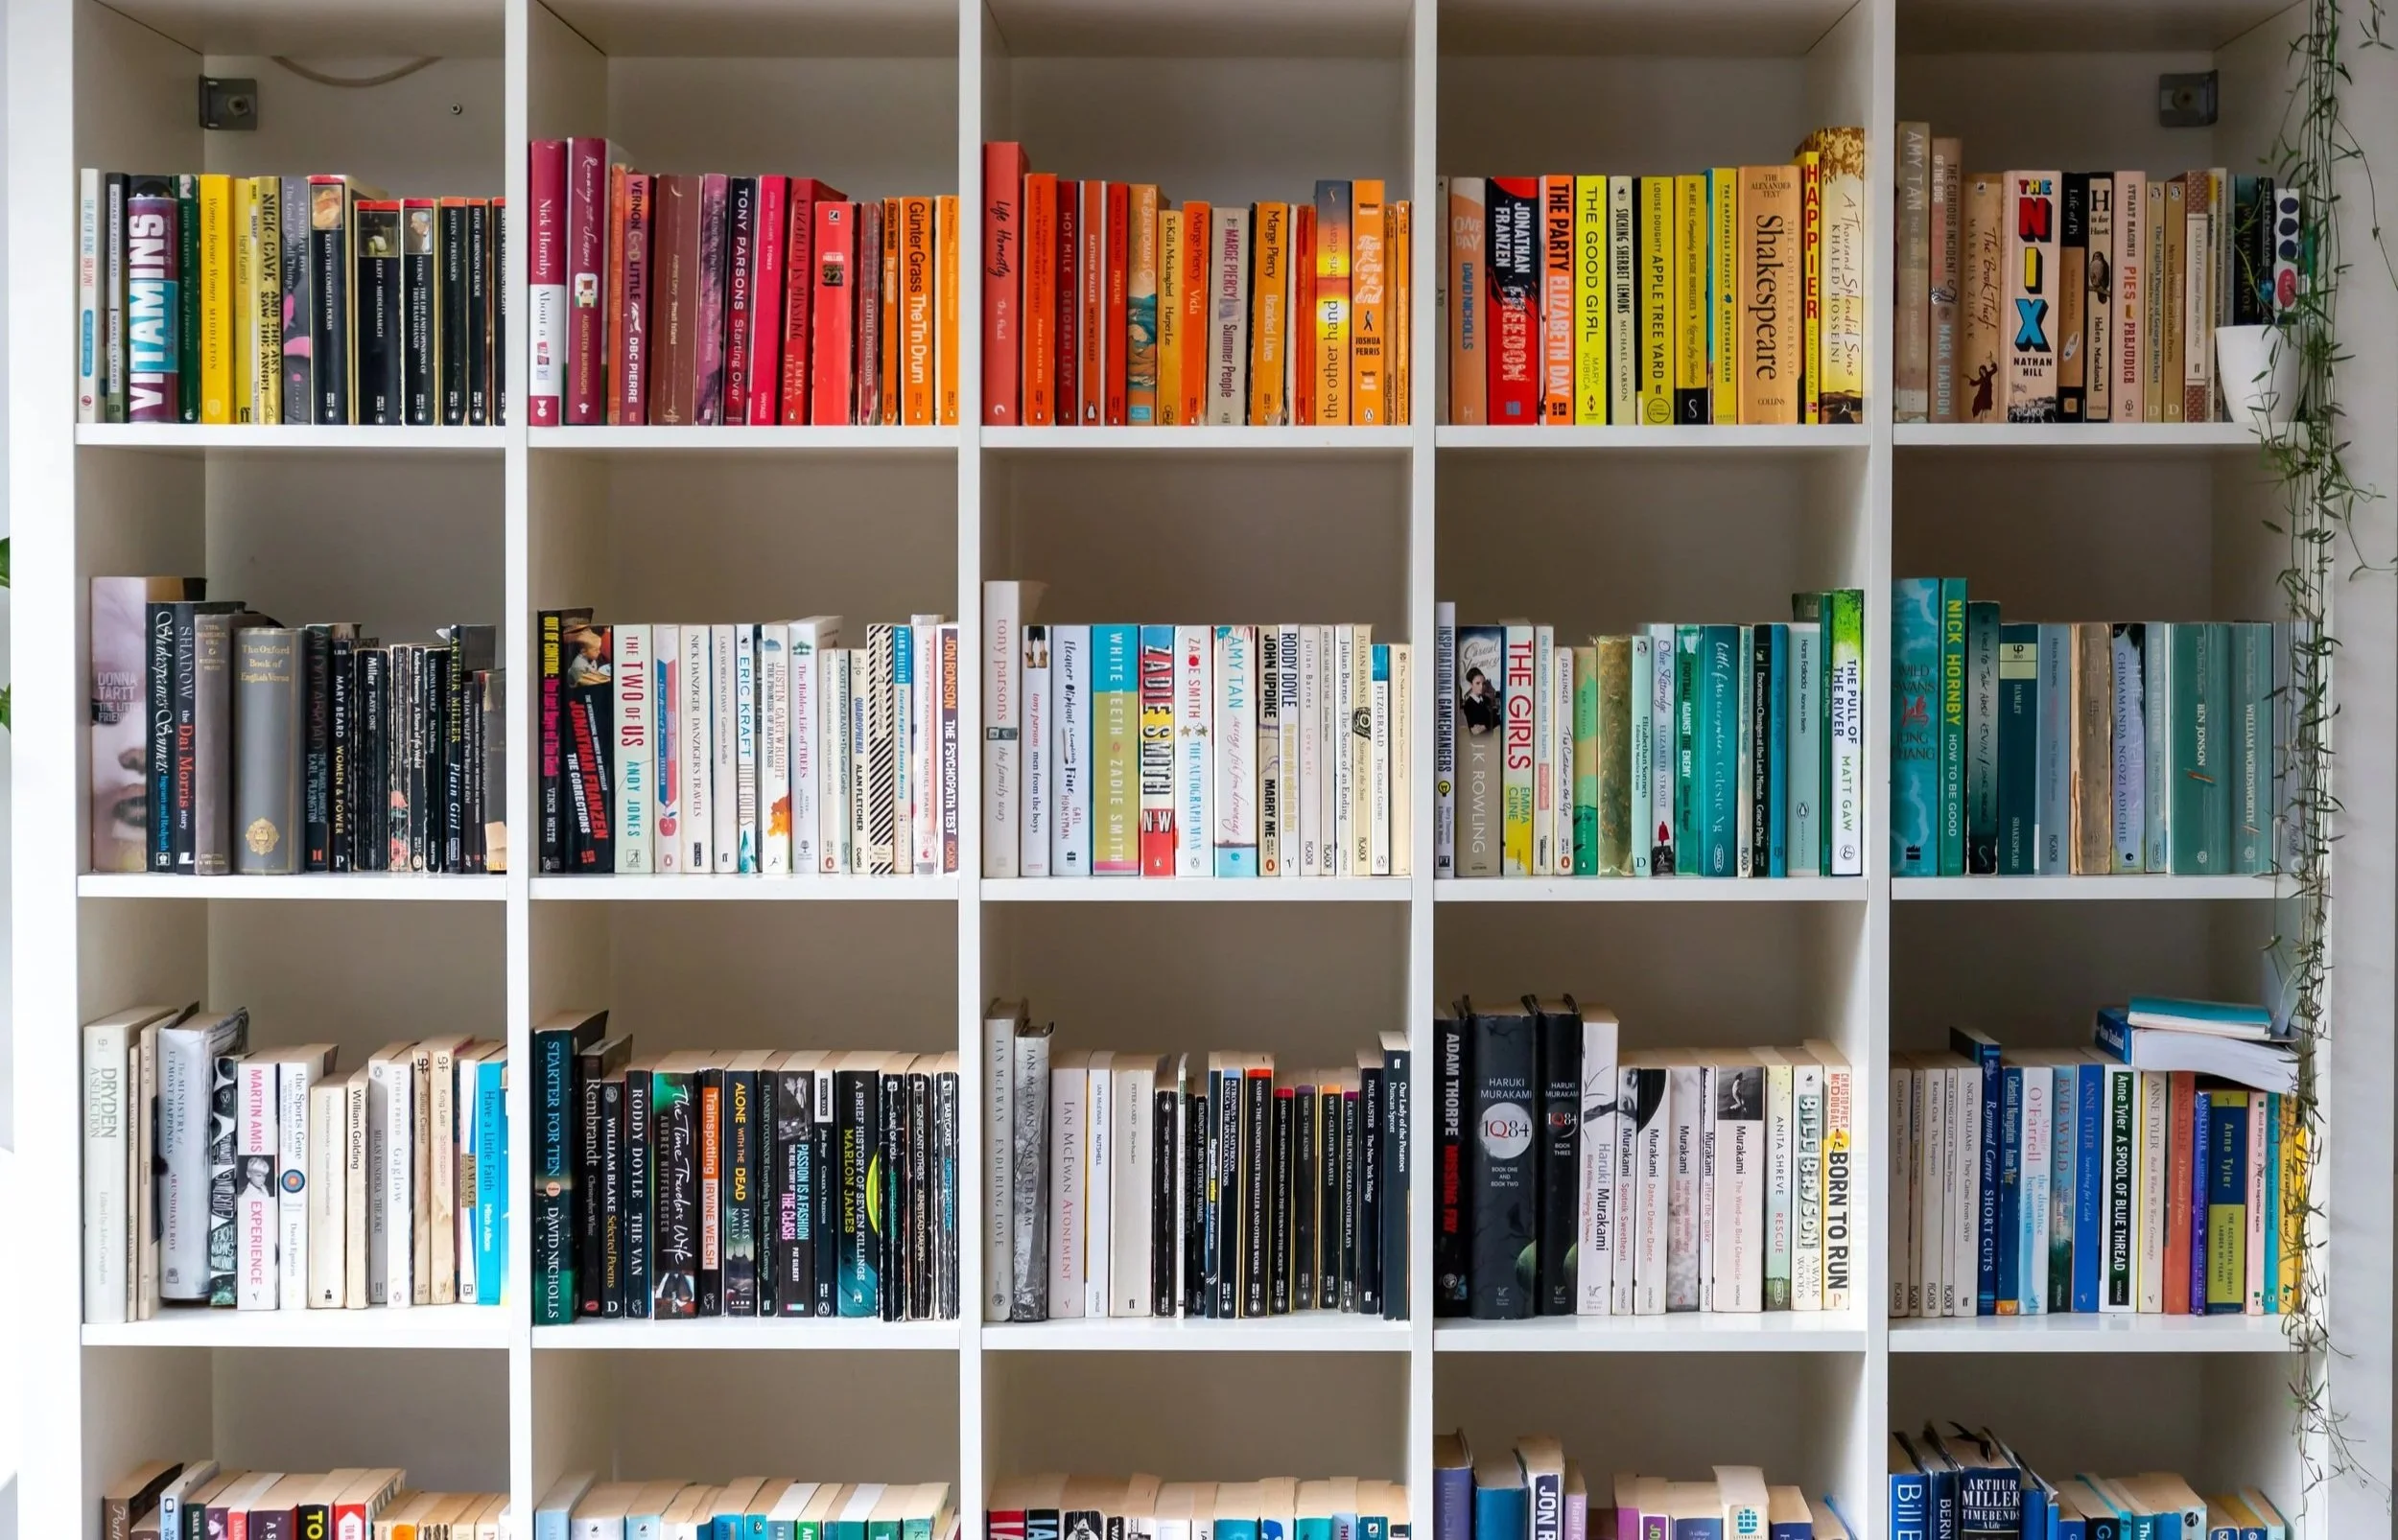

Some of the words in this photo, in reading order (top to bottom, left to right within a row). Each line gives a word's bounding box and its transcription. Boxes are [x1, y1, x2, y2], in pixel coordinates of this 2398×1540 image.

[1907, 131, 1922, 167] AMY
[630, 181, 643, 229] VERNON
[738, 189, 748, 230] TONY
[1549, 184, 1569, 213] THE
[1586, 186, 1598, 223] THE
[1907, 175, 1922, 210] TAN
[539, 199, 551, 227] Nick
[908, 202, 925, 249] Günter
[1062, 212, 1071, 239] HOT
[1615, 209, 1629, 242] SUCKING
[536, 232, 551, 277] Hornby
[1224, 229, 1238, 262] MARGE
[1495, 207, 1510, 267] FRANZEN
[1514, 202, 1530, 273] JONATHAN
[1549, 219, 1569, 271] PARTY
[1806, 164, 1818, 318] HAPPIER
[735, 237, 747, 310] PARSONS
[909, 251, 925, 292] Grass
[1062, 245, 1071, 273] MILK
[1586, 231, 1598, 289] GOOD
[1616, 245, 1630, 279] SHERBET
[1652, 256, 1663, 298] APPLE
[630, 261, 641, 299] LITTLE
[1224, 265, 1238, 298] PIERCY
[1617, 284, 1631, 314] LEMONS
[1748, 215, 1784, 381] Shakespeare
[2124, 267, 2136, 299] PIES
[129, 215, 164, 412] VITAMINS
[1324, 301, 1338, 340] hand
[1549, 276, 1569, 359] ELIZABETH
[1652, 304, 1663, 338] TREE
[2093, 316, 2103, 343] Helen
[629, 338, 639, 360] DBC
[732, 319, 743, 367] Starting
[1222, 325, 1236, 363] Summer
[1653, 343, 1663, 379] YARD
[2013, 358, 2053, 366] NATHAN
[2124, 322, 2135, 384] PREJUDICE
[628, 363, 638, 403] PIERRE
[911, 345, 926, 383] Drum
[1219, 366, 1235, 397] People
[1326, 346, 1338, 387] other
[1549, 365, 1569, 396] DAY
[2023, 368, 2043, 377] HILL
[2094, 347, 2103, 391] Macdonald
[732, 372, 742, 401] Over
[1324, 394, 1336, 419] the
[1947, 600, 1962, 644] NICK
[451, 637, 460, 691] ARTHUR
[625, 637, 638, 655] THE
[1110, 633, 1122, 682] WHITE
[1264, 634, 1276, 669] JOHN
[1508, 641, 1531, 687] THE
[622, 662, 644, 701] TWO
[740, 657, 750, 697] ERIC
[1834, 667, 1843, 694] THE
[1847, 660, 1856, 688] THE
[1946, 655, 1961, 726] HORNBY
[625, 708, 640, 720] OF
[1110, 689, 1123, 735] TEETH
[1264, 673, 1276, 718] UPDIKE
[1847, 690, 1856, 721] PULL
[2013, 685, 2022, 714] HAMLET
[2118, 652, 2127, 739] CHIMAMANDA
[2197, 704, 2205, 722] BEN
[451, 697, 460, 743] MILLER
[740, 703, 750, 758] KRAFT
[855, 697, 864, 754] QUADROPHENIA
[945, 720, 956, 740] THE
[1508, 695, 1532, 769] GIRLS
[1834, 698, 1844, 736] RIVER
[1847, 726, 1856, 744] OF
[622, 726, 644, 747] US
[1948, 735, 1957, 760] HOW
[2197, 727, 2206, 765] JONSON
[335, 746, 343, 784] WOMEN
[449, 763, 459, 800] Plain
[627, 761, 640, 791] ANDY
[945, 742, 956, 808] PSYCHOPATH
[1111, 759, 1123, 805] ZADIE
[1842, 757, 1851, 795] MATT
[1948, 766, 1957, 780] TO
[2118, 746, 2127, 786] NGOZI
[1265, 780, 1275, 818] MARRY
[1509, 788, 1518, 820] CLINE
[1520, 787, 1530, 824] EMMA
[1948, 784, 1957, 798] BE
[335, 800, 343, 834] POWER
[450, 805, 459, 830] Girl
[627, 800, 640, 836] JONES
[946, 811, 956, 835] TEST
[1265, 821, 1275, 837] ME
[1471, 771, 1484, 853] ROWLING
[1842, 800, 1851, 830] GAW
[1948, 803, 1957, 836] GOOD
[2118, 790, 2127, 843] ADICHIE
[1111, 814, 1123, 862] SMITH
[2011, 817, 2020, 868] SHAKESPEARE
[1446, 1033, 1460, 1076] ADAM
[250, 1069, 262, 1117] MARTIN
[547, 1041, 559, 1107] STARTER
[2116, 1075, 2128, 1101] Anne
[101, 1067, 117, 1138] DRYDEN
[352, 1089, 362, 1129] William
[1388, 1110, 1397, 1133] Sprott
[1445, 1080, 1459, 1136] THORPE
[2114, 1105, 2128, 1130] Tyler
[250, 1120, 262, 1153] AMIS
[548, 1113, 559, 1142] FOR
[586, 1078, 600, 1166] Rembrandt
[703, 1091, 717, 1175] Trainspotting
[1984, 1101, 1996, 1145] Raymond
[350, 1131, 362, 1170] Golding
[548, 1145, 559, 1177] TEN
[607, 1118, 616, 1171] WILLIAM
[844, 1130, 854, 1184] MARLON
[1598, 1143, 1610, 1184] Haruki
[2115, 1146, 2127, 1179] SPOOL
[1829, 1152, 1849, 1206] BORN
[1985, 1150, 1996, 1181] Carver
[607, 1175, 616, 1212] BLAKE
[706, 1182, 715, 1222] IRVINE
[2115, 1182, 2127, 1197] OF
[547, 1207, 559, 1248] DAVID
[845, 1189, 854, 1233] JAMES
[1596, 1188, 1610, 1250] Murakami
[1828, 1212, 1848, 1239] TO
[1984, 1189, 1994, 1235] SHORT
[2115, 1199, 2127, 1227] BLUE
[250, 1201, 262, 1285] EXPERIENCE
[705, 1225, 715, 1265] WELSH
[1983, 1238, 1993, 1272] CUTS
[2114, 1229, 2126, 1271] THREAD
[548, 1251, 559, 1318] NICHOLLS
[1828, 1246, 1848, 1290] RUN
[1897, 1484, 1922, 1522] Bill
[1963, 1491, 2020, 1507] MILLER
[1968, 1479, 2016, 1490] ARTHUR
[1537, 1486, 1557, 1525] JON
[1963, 1509, 2020, 1520] TIMEBENDS
